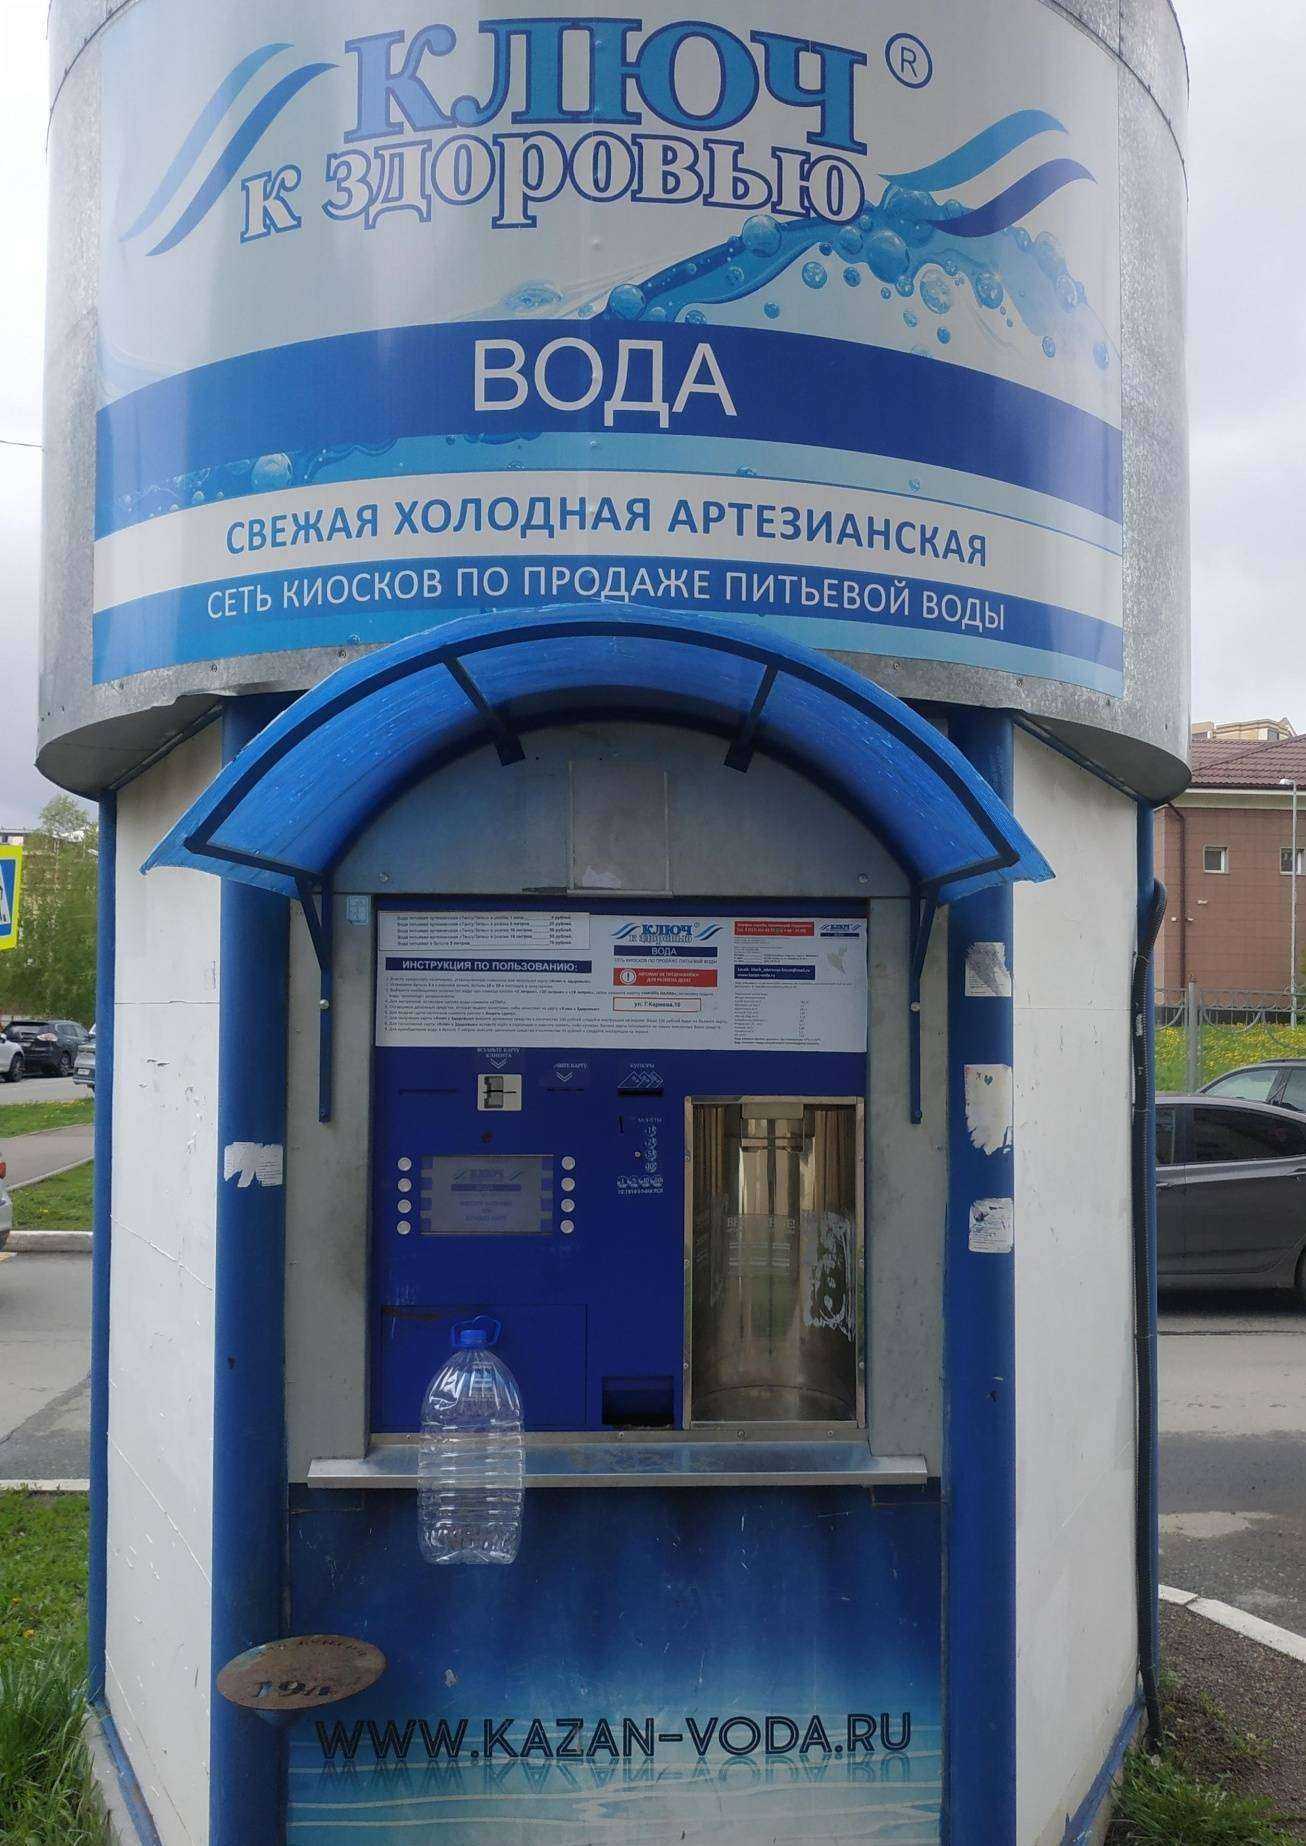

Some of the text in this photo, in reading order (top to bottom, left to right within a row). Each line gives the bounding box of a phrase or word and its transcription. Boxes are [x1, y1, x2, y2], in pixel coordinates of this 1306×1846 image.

[322, 128, 866, 230] здоровью
[474, 336, 738, 429] ВОДА
[226, 496, 987, 568] СВЕЖАЯ ХОЛОДНАЯ АРТЕЗИАНСКАЯ
[206, 566, 1005, 631] СЕТЬ КИОСКОВ ПО ПРОДАЖЕ ПИТЬЕВОЙ ВОДЫ
[402, 960, 578, 972] ИНСТРУКЦИЯ ПО ПОЛЬЗОВАНИЮ:
[651, 947, 678, 956] ВОДА
[315, 1711, 912, 1760] WWW.KAZAN-VODA.RU
